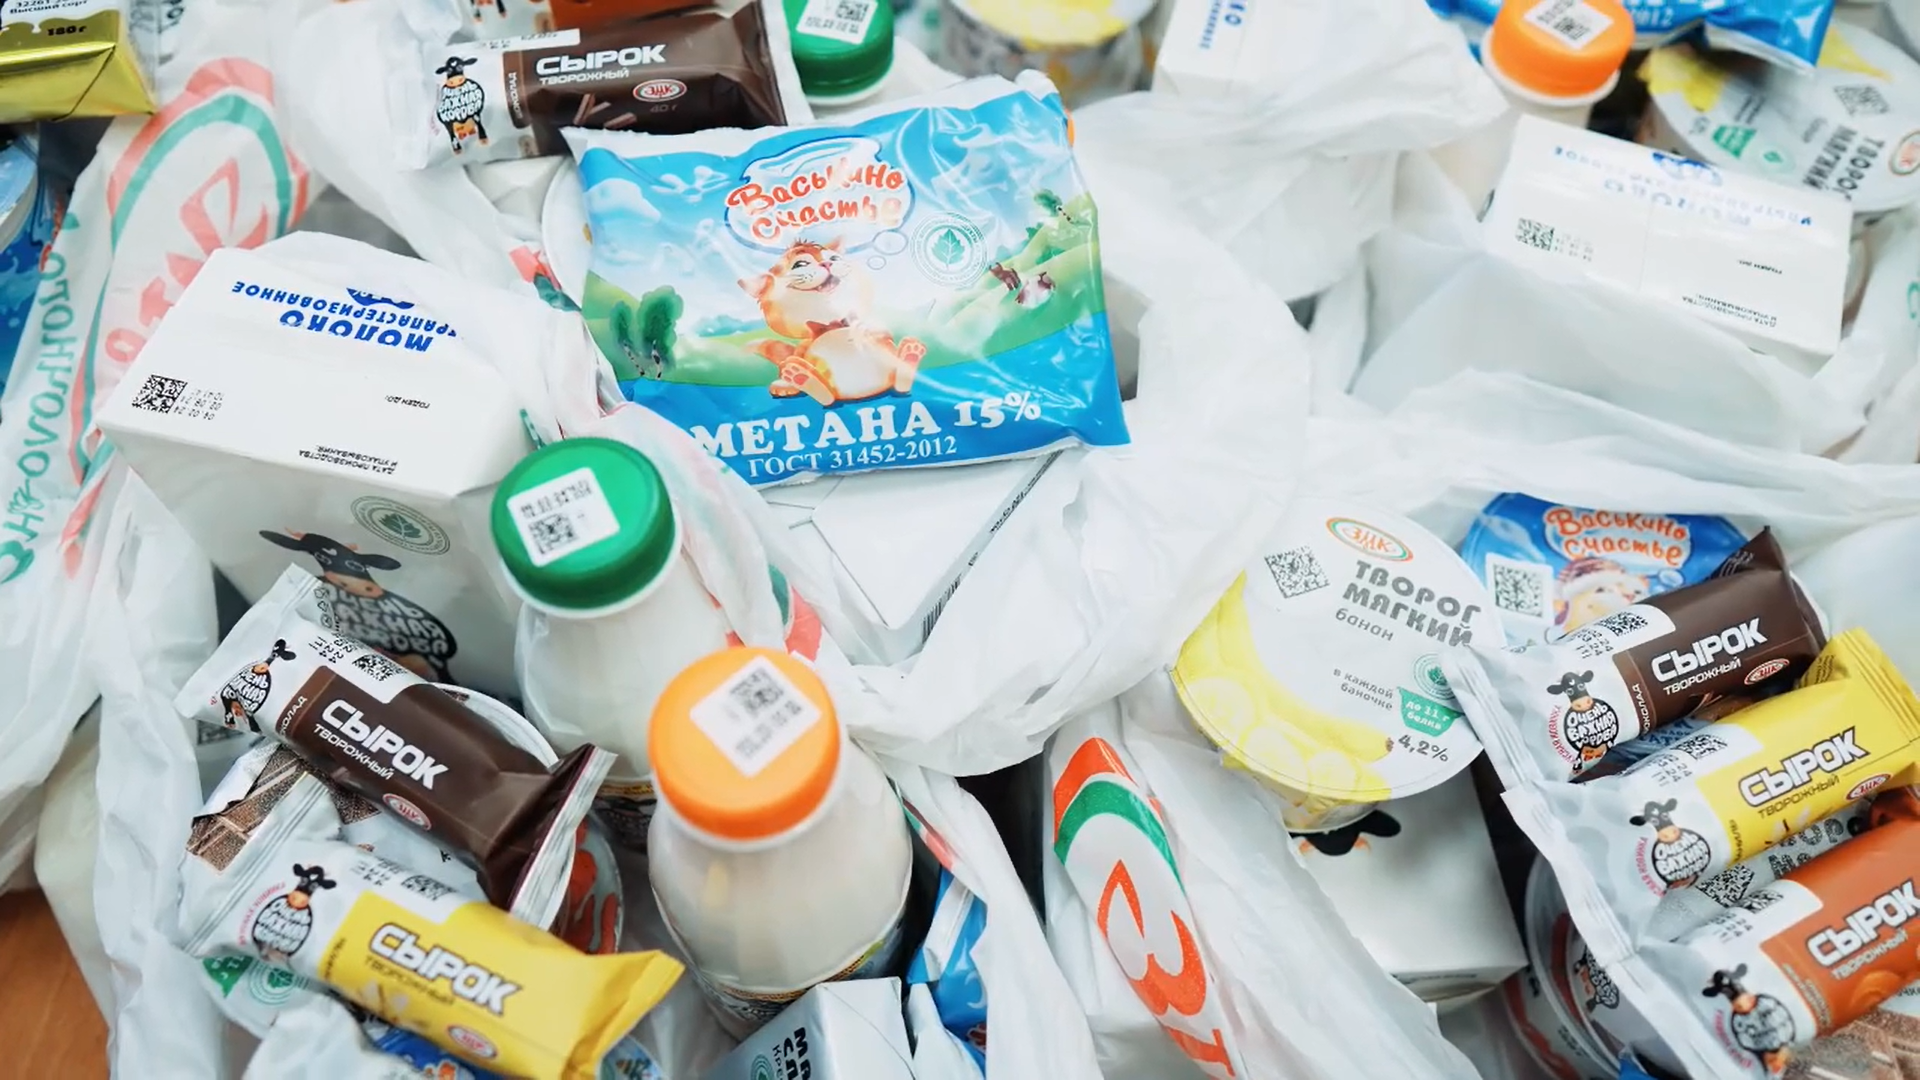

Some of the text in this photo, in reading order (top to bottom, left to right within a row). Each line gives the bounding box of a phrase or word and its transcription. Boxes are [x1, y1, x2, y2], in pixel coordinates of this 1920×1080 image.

[536, 44, 667, 76] СЫРОК
[539, 67, 630, 86] ТВОРОЖНЫЙ
[726, 156, 905, 216] Васькино
[279, 309, 434, 352] МОЛОКО
[401, 397, 431, 409] ГОДЕН
[690, 390, 1042, 459] МЕТАНА 15%
[298, 449, 396, 475] ДАТА ПРОИЗВОДСТВА
[748, 435, 958, 478] ГОСТ 31452-2012
[1546, 507, 1688, 541] Васькино
[1355, 560, 1482, 624] ТВОРОГ
[1335, 607, 1395, 642] банан
[1342, 582, 1473, 648] МЯГКИЙ
[1651, 617, 1768, 683] СЫРОК
[1332, 667, 1342, 677] в
[1344, 671, 1394, 700] каждой
[1340, 682, 1394, 711] баночке
[1662, 656, 1742, 696] ТВОРОЖНЫЙ
[1405, 700, 1422, 713] до
[1425, 705, 1440, 719] 11
[1406, 711, 1443, 731] белка
[1566, 701, 1609, 728] ОЧЕНЬ
[1566, 711, 1617, 742] ВАЖНАЯ
[312, 722, 396, 781] ТВОРОЖНЫЙ
[321, 698, 449, 791] СЫРОК
[1398, 734, 1449, 763] 4,2%
[1738, 726, 1871, 808] СЫРОК
[1757, 774, 1841, 820] ТВОРОЖНЫЙ
[1806, 877, 1920, 967] СЫРОК
[369, 922, 523, 1018] СЫРОК
[1832, 927, 1909, 980] ТВОРОЖНЫЙ
